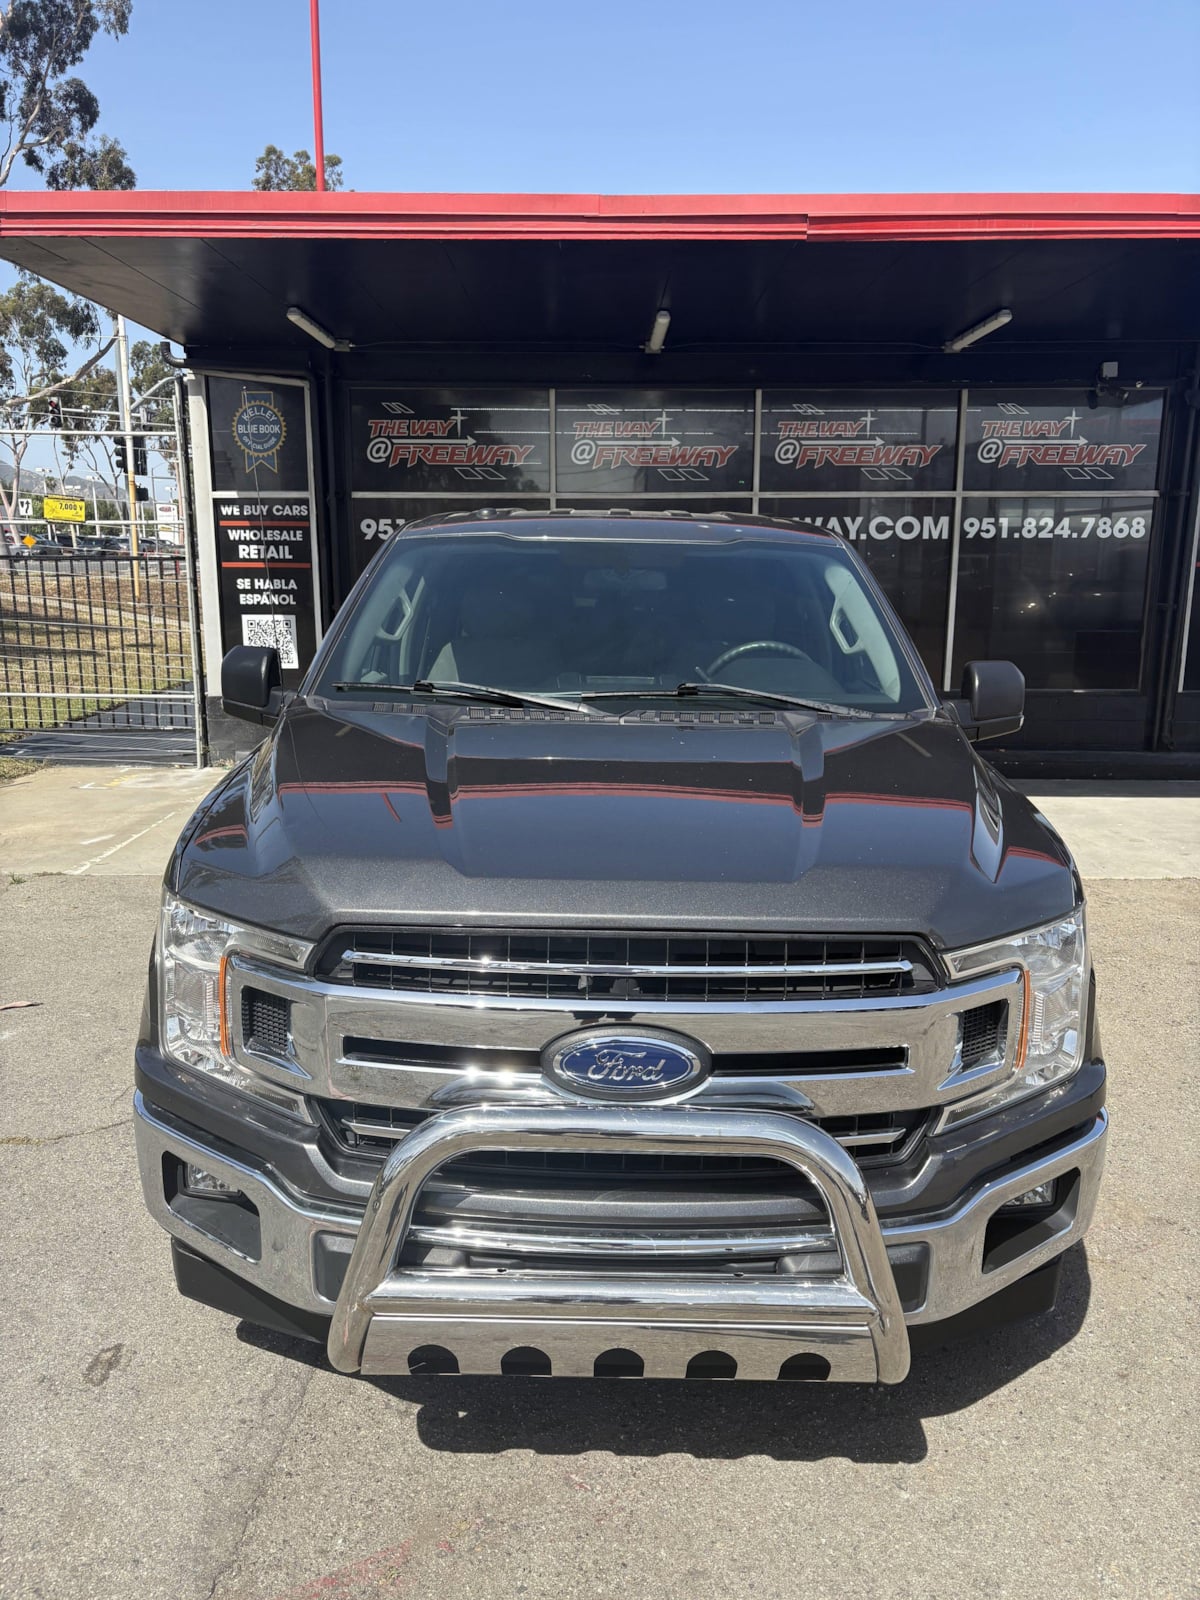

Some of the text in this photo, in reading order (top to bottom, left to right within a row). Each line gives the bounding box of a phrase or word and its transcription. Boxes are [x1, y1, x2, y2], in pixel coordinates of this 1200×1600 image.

[241, 407, 278, 422] KELLEY
[237, 424, 281, 434] BLUE BOOK
[367, 437, 535, 468] @FREEWAY
[571, 439, 739, 470] @FREEWAY
[774, 439, 943, 469] @FREEWAY
[977, 438, 1147, 469] @FREEWAY
[220, 504, 309, 516] WE BUY CARS
[227, 529, 304, 541] WHOLESALE
[963, 517, 1146, 539] 951.824.7868
[238, 544, 293, 559] RETAIL
[236, 578, 298, 590] SE HABLA
[239, 591, 297, 605] ESPAÑOL
[587, 1049, 666, 1081] Ford
